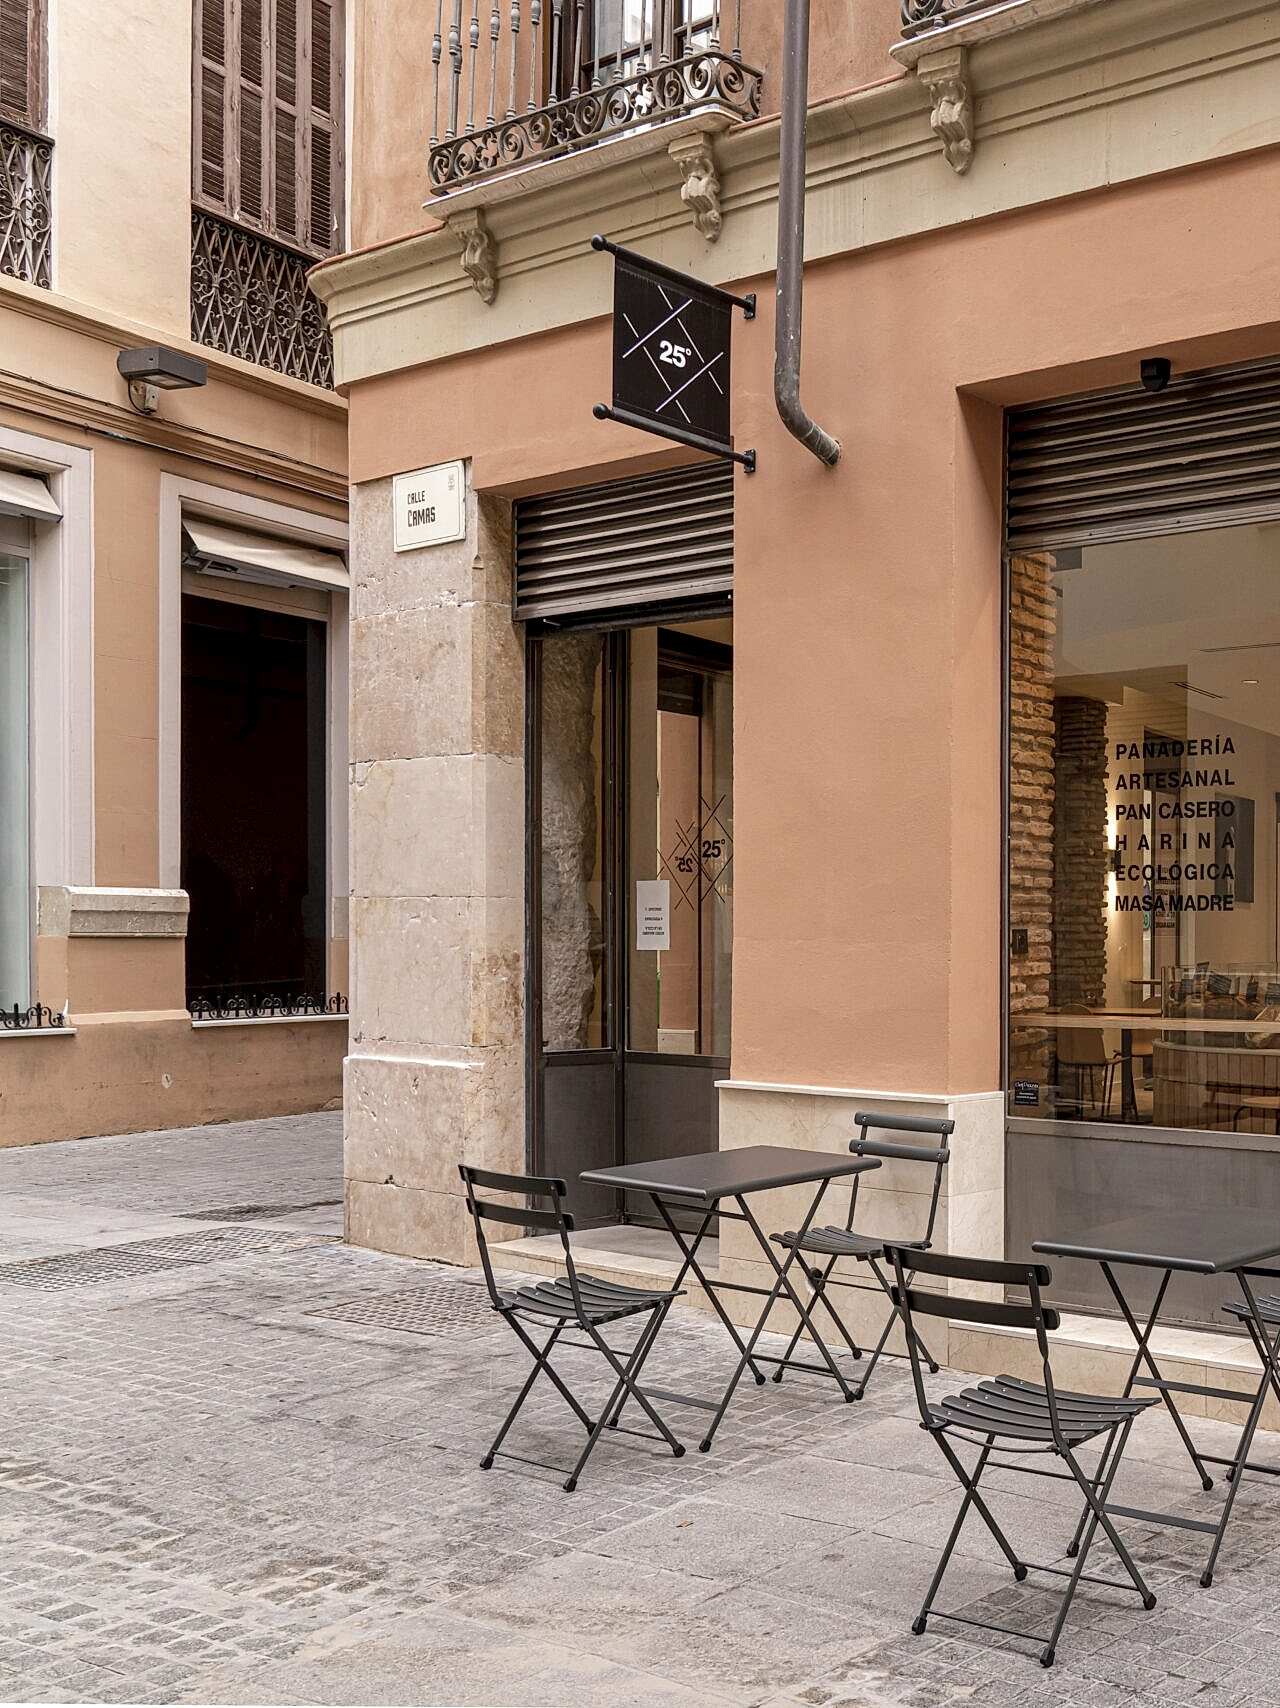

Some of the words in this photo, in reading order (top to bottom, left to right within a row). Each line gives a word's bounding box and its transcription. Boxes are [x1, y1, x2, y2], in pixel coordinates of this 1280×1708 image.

[659, 340, 692, 368] 25°
[407, 490, 426, 505] CALLE
[407, 506, 436, 528] CAMAS
[1115, 734, 1236, 761] PANADERÍA
[1115, 768, 1236, 791] ARTESANAL
[1115, 803, 1151, 821] PAN
[1158, 800, 1236, 819] CASERO
[1115, 831, 1236, 851] HARINA
[1115, 860, 1235, 881] ECOLÓGICA
[1115, 895, 1166, 912] MASA
[1168, 895, 1234, 911] MADRE
